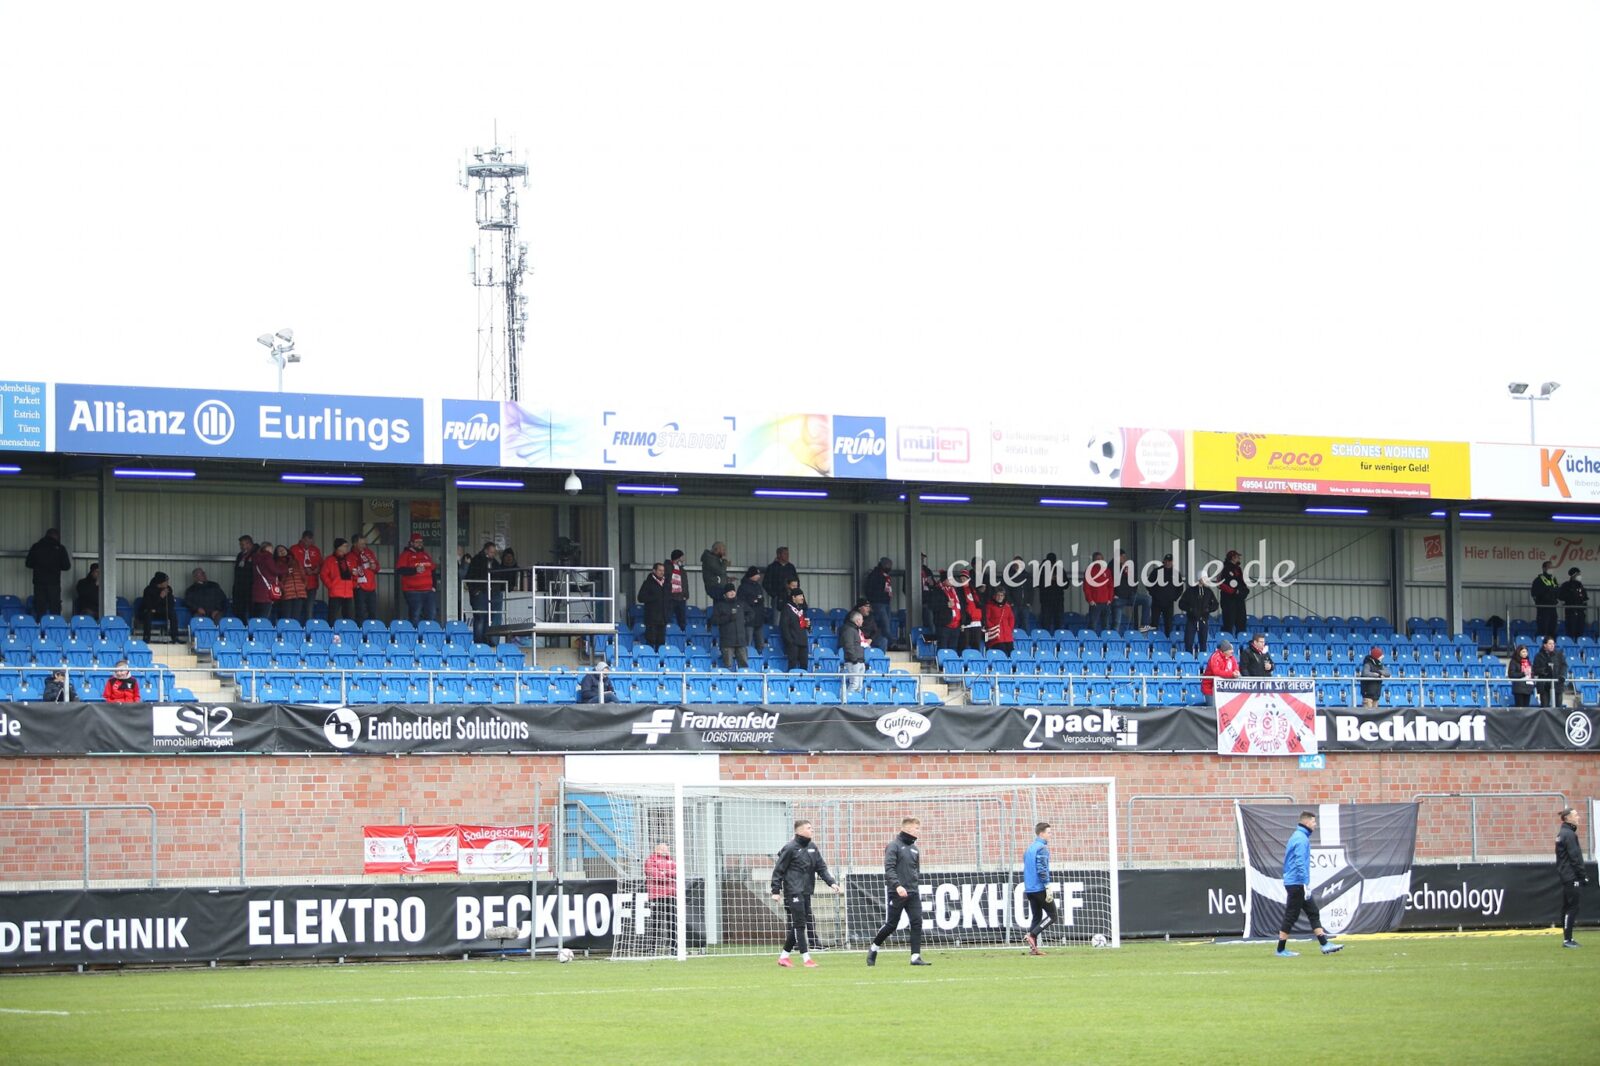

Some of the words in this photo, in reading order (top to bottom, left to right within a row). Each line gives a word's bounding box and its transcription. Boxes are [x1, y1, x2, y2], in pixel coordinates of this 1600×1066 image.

[14, 395, 40, 405] Parkett
[14, 409, 40, 419] Estrich
[69, 400, 186, 435] Allianz
[17, 423, 40, 433] Türen
[259, 405, 411, 451] Eurlings
[443, 421, 500, 442] FRIMO
[834, 436, 885, 456] FRIMO
[903, 435, 960, 451] müller
[1268, 451, 1323, 466] POCO
[1332, 442, 1381, 458] SCHÖNES
[1384, 445, 1430, 460] WOHNEN
[1360, 462, 1372, 471] für
[1375, 463, 1406, 474] weniger
[1408, 463, 1430, 473] Geld!
[1241, 480, 1263, 490] 49504
[1464, 546, 1489, 559] Hier
[1492, 546, 1524, 560] fallen
[1527, 547, 1546, 561] die
[367, 715, 452, 740] Embedded
[456, 715, 530, 740] Solutions
[680, 711, 779, 730] Frankenfeld
[883, 716, 924, 731] Gutfried
[1336, 716, 1486, 742] Beckhoff
[701, 731, 775, 743] LOGISTIKGRUPPE
[1062, 733, 1116, 745] Verpackungen
[248, 896, 427, 946] ELEKTRO
[457, 892, 650, 941] BECKHOFF
[1330, 908, 1348, 917] 1924
[0, 917, 189, 953] DETECHNIK
